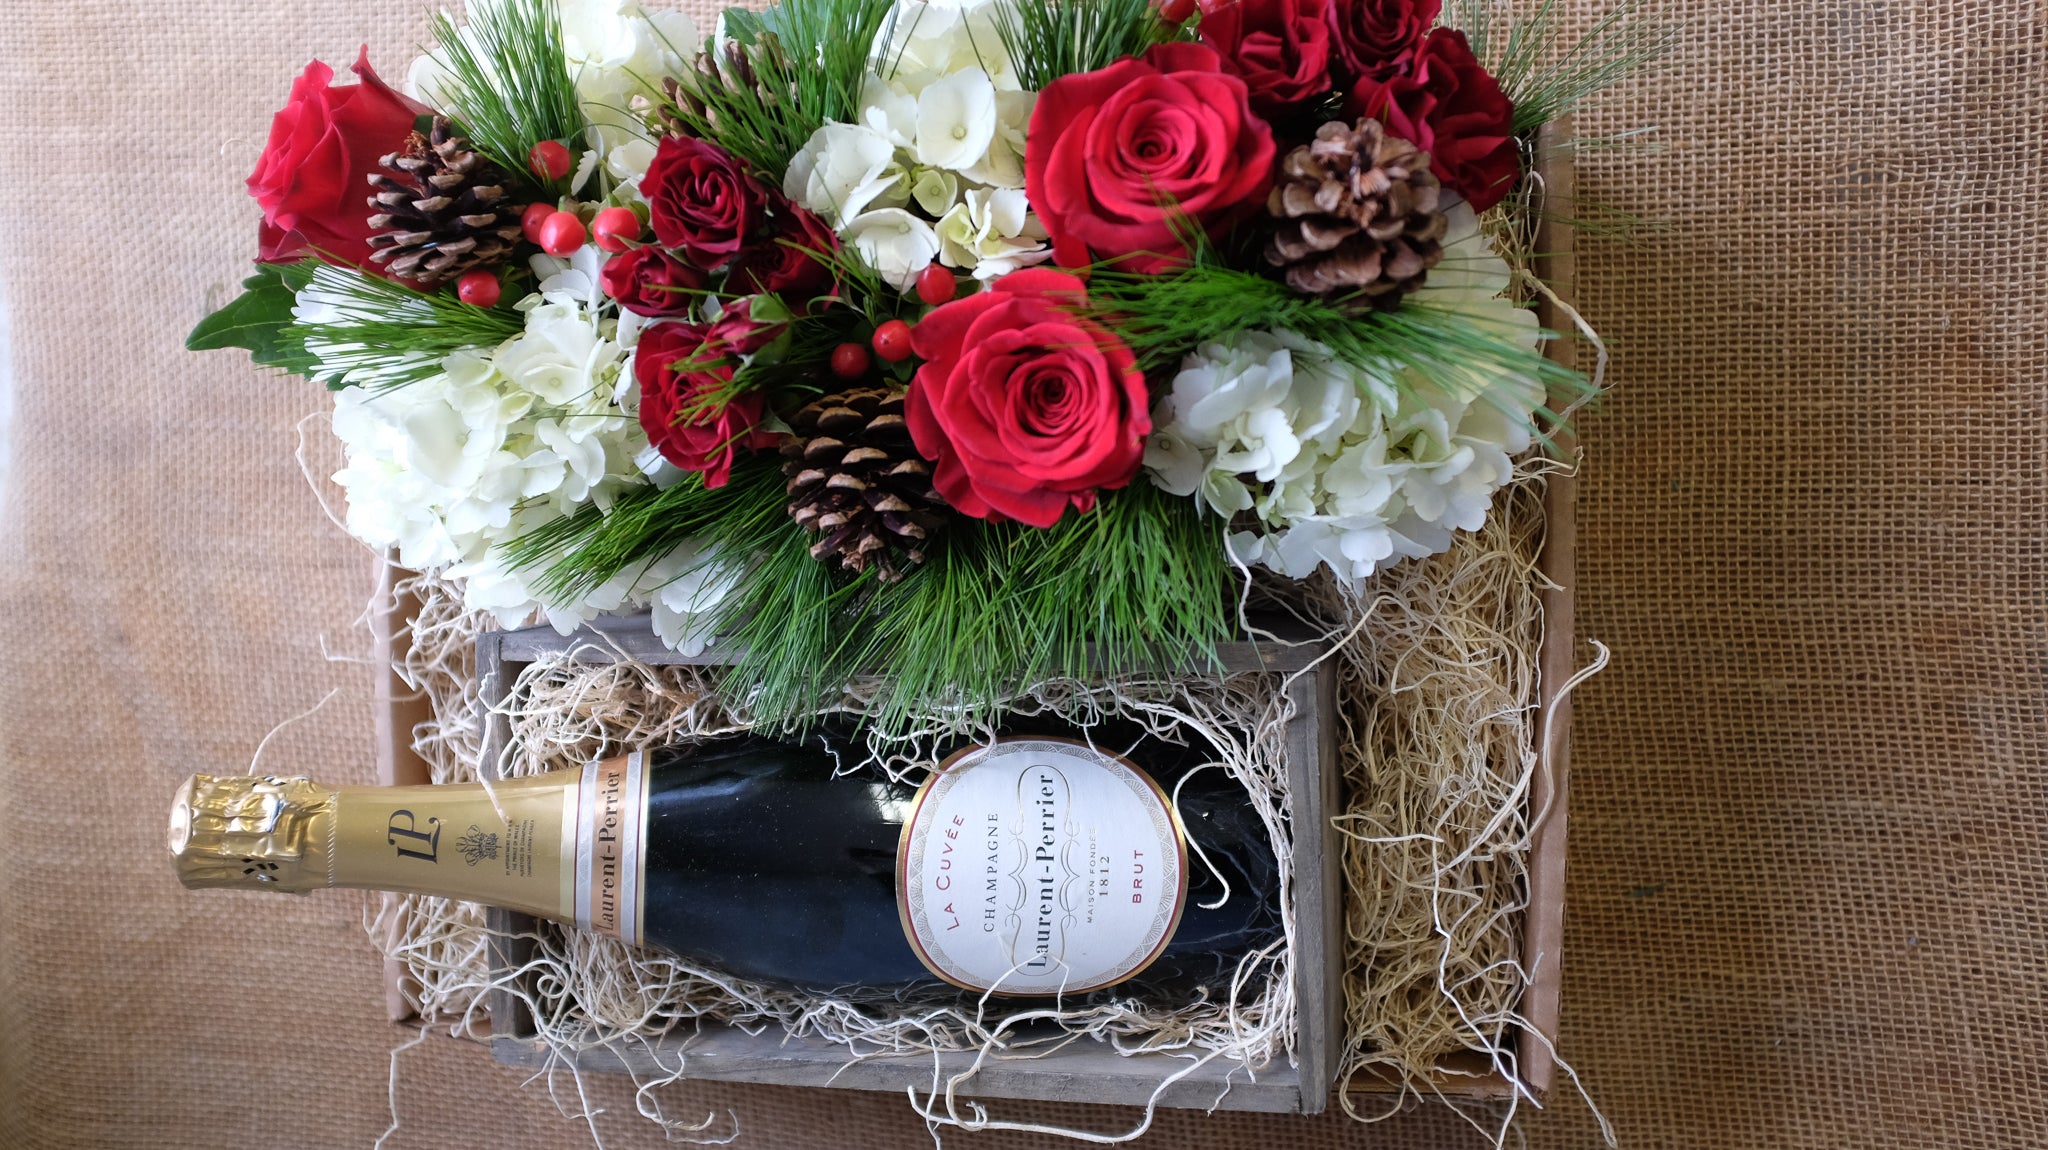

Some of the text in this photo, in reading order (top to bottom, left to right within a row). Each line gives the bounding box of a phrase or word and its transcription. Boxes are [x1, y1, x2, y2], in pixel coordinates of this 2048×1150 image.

[597, 772, 620, 931] Laurent-Perrier
[936, 814, 965, 931] LA CUVÉE
[983, 812, 999, 932] CHAMPAGNE
[1027, 774, 1055, 968] Laurent-Perrier
[1087, 881, 1095, 924] MAISON
[1099, 856, 1110, 896] 1812
[1132, 850, 1144, 903] BRUT
